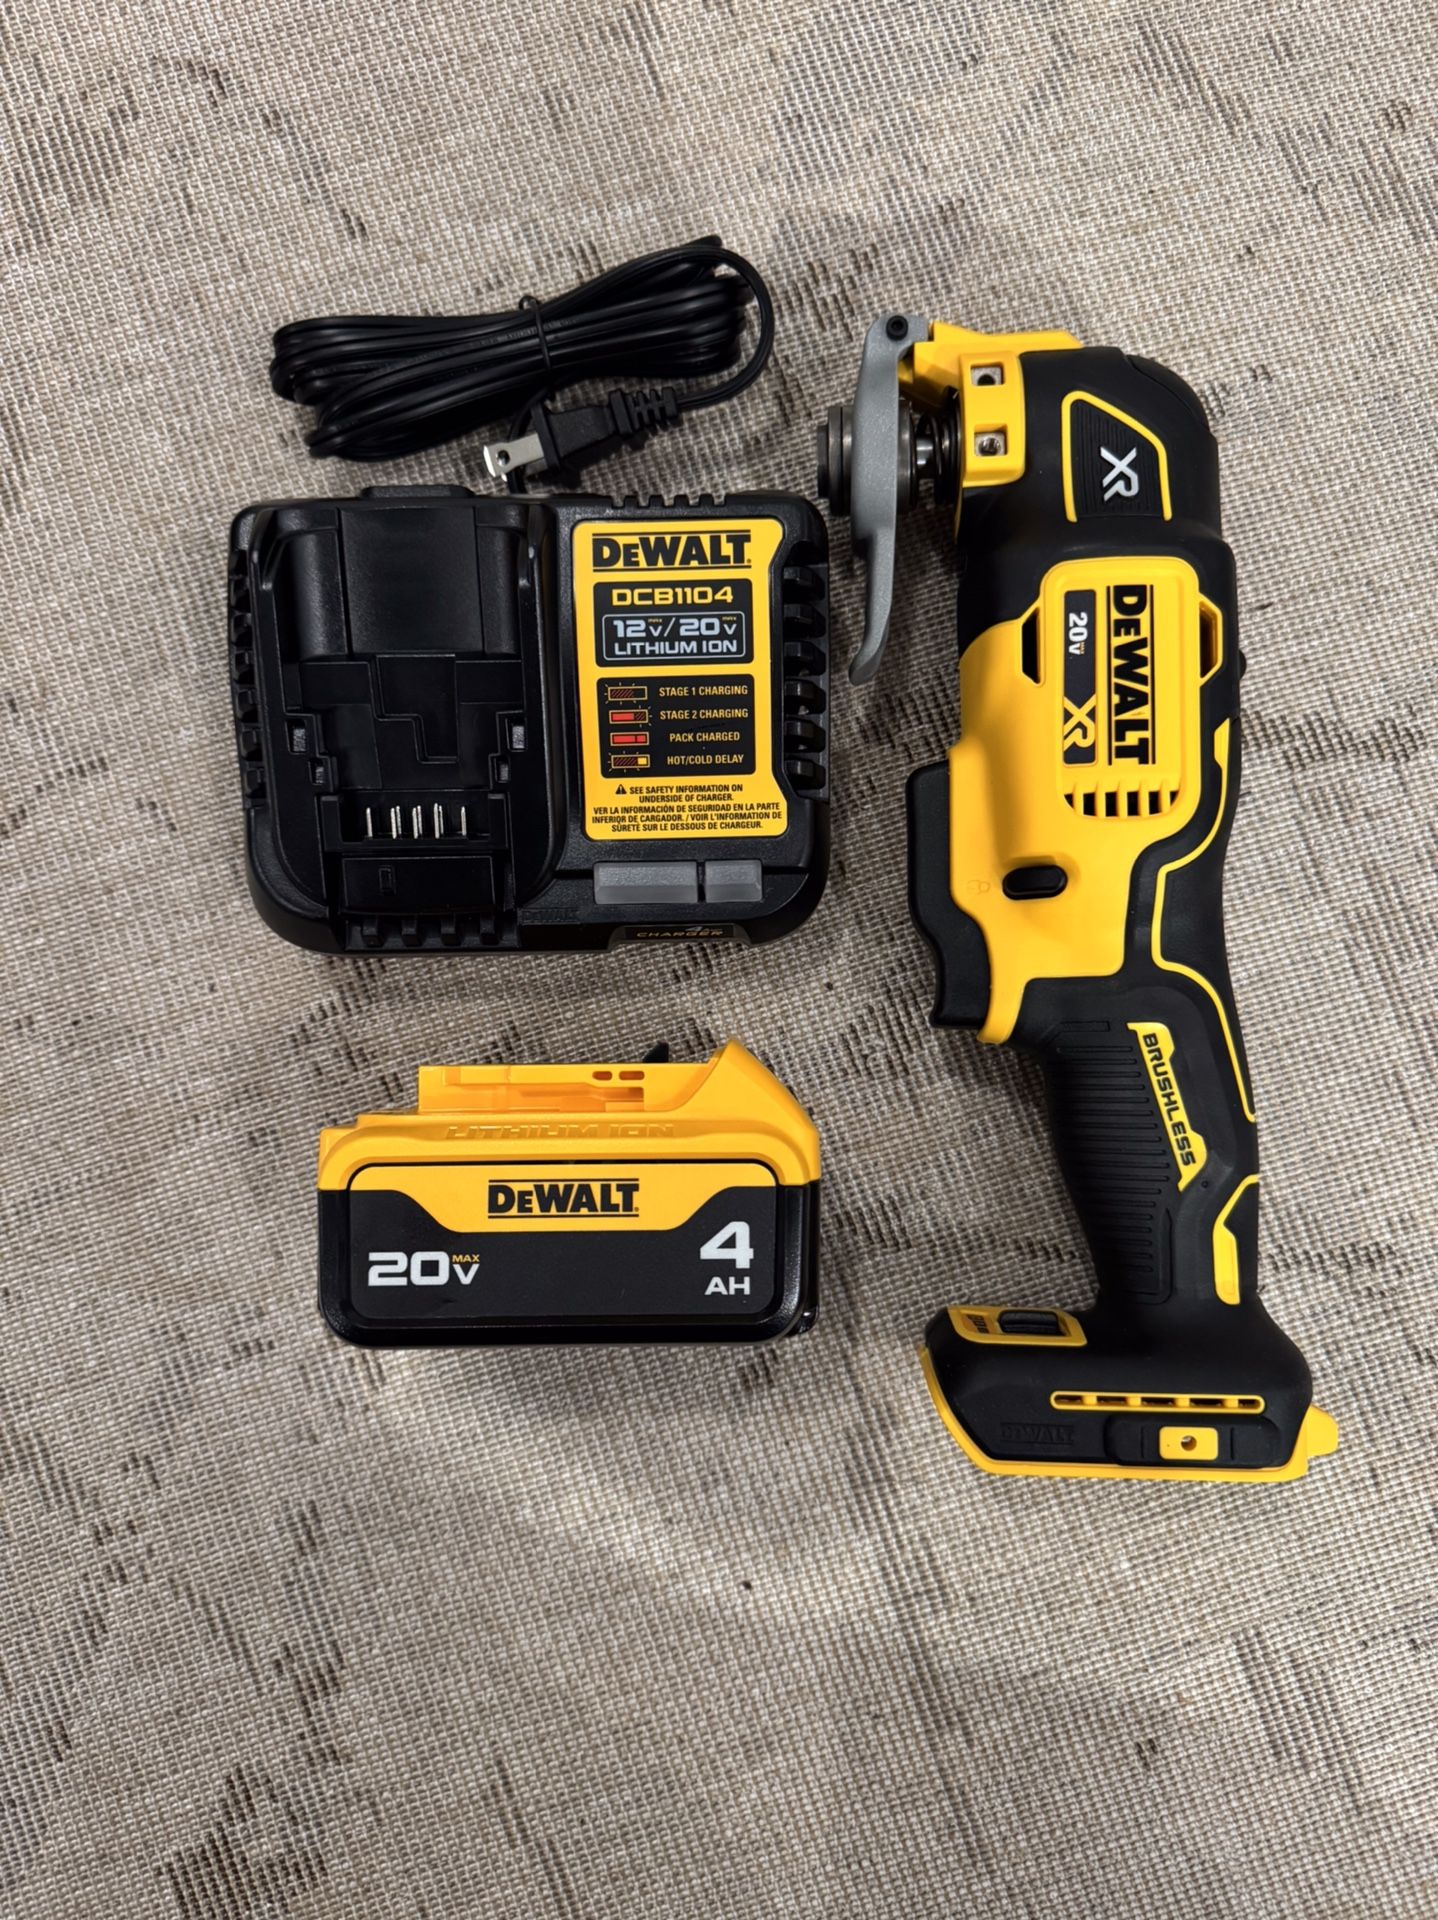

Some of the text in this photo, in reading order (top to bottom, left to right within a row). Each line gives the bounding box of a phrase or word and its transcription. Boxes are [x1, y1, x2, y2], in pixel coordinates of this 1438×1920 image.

[1100, 446, 1140, 502] XR
[592, 533, 752, 568] DEWALT
[611, 586, 734, 606] DCB1104
[614, 639, 737, 656] LITHIUM ION
[1112, 584, 1150, 765] DEWALT
[659, 685, 749, 697] STAGE 1 CHARGING
[660, 708, 749, 720] STAGE 2 CHARGING
[1063, 694, 1096, 752] XR
[669, 731, 740, 742] PACK CHARGED
[667, 754, 745, 766] HOT/COLD DELAY
[629, 784, 743, 794] SEE SAFETY INFORMATION ON
[639, 793, 734, 803] UNDERSIDE OF CHARGER.
[593, 802, 780, 815] VER LA INFORMACIÓN DE SEGURIDAD EN LA PARTE
[592, 815, 627, 824] INFERIOR
[628, 815, 638, 823] DE
[640, 814, 684, 823] CARGADOR.
[690, 813, 711, 822] VOIR
[712, 812, 771, 821] L'INFORMATION
[772, 811, 782, 820] DE
[642, 823, 658, 832] SUR
[659, 823, 669, 831] LE
[670, 822, 706, 831] DESSOUS
[707, 822, 718, 830] DE
[719, 820, 762, 830] CHARGEUR.
[1142, 1032, 1196, 1167] BRUSHLESS
[446, 1124, 674, 1140] LITHIUM ION
[488, 1181, 640, 1216] DEWALT
[699, 1220, 755, 1270] 4
[452, 1254, 480, 1263] MAX
[704, 1277, 750, 1296] AH
